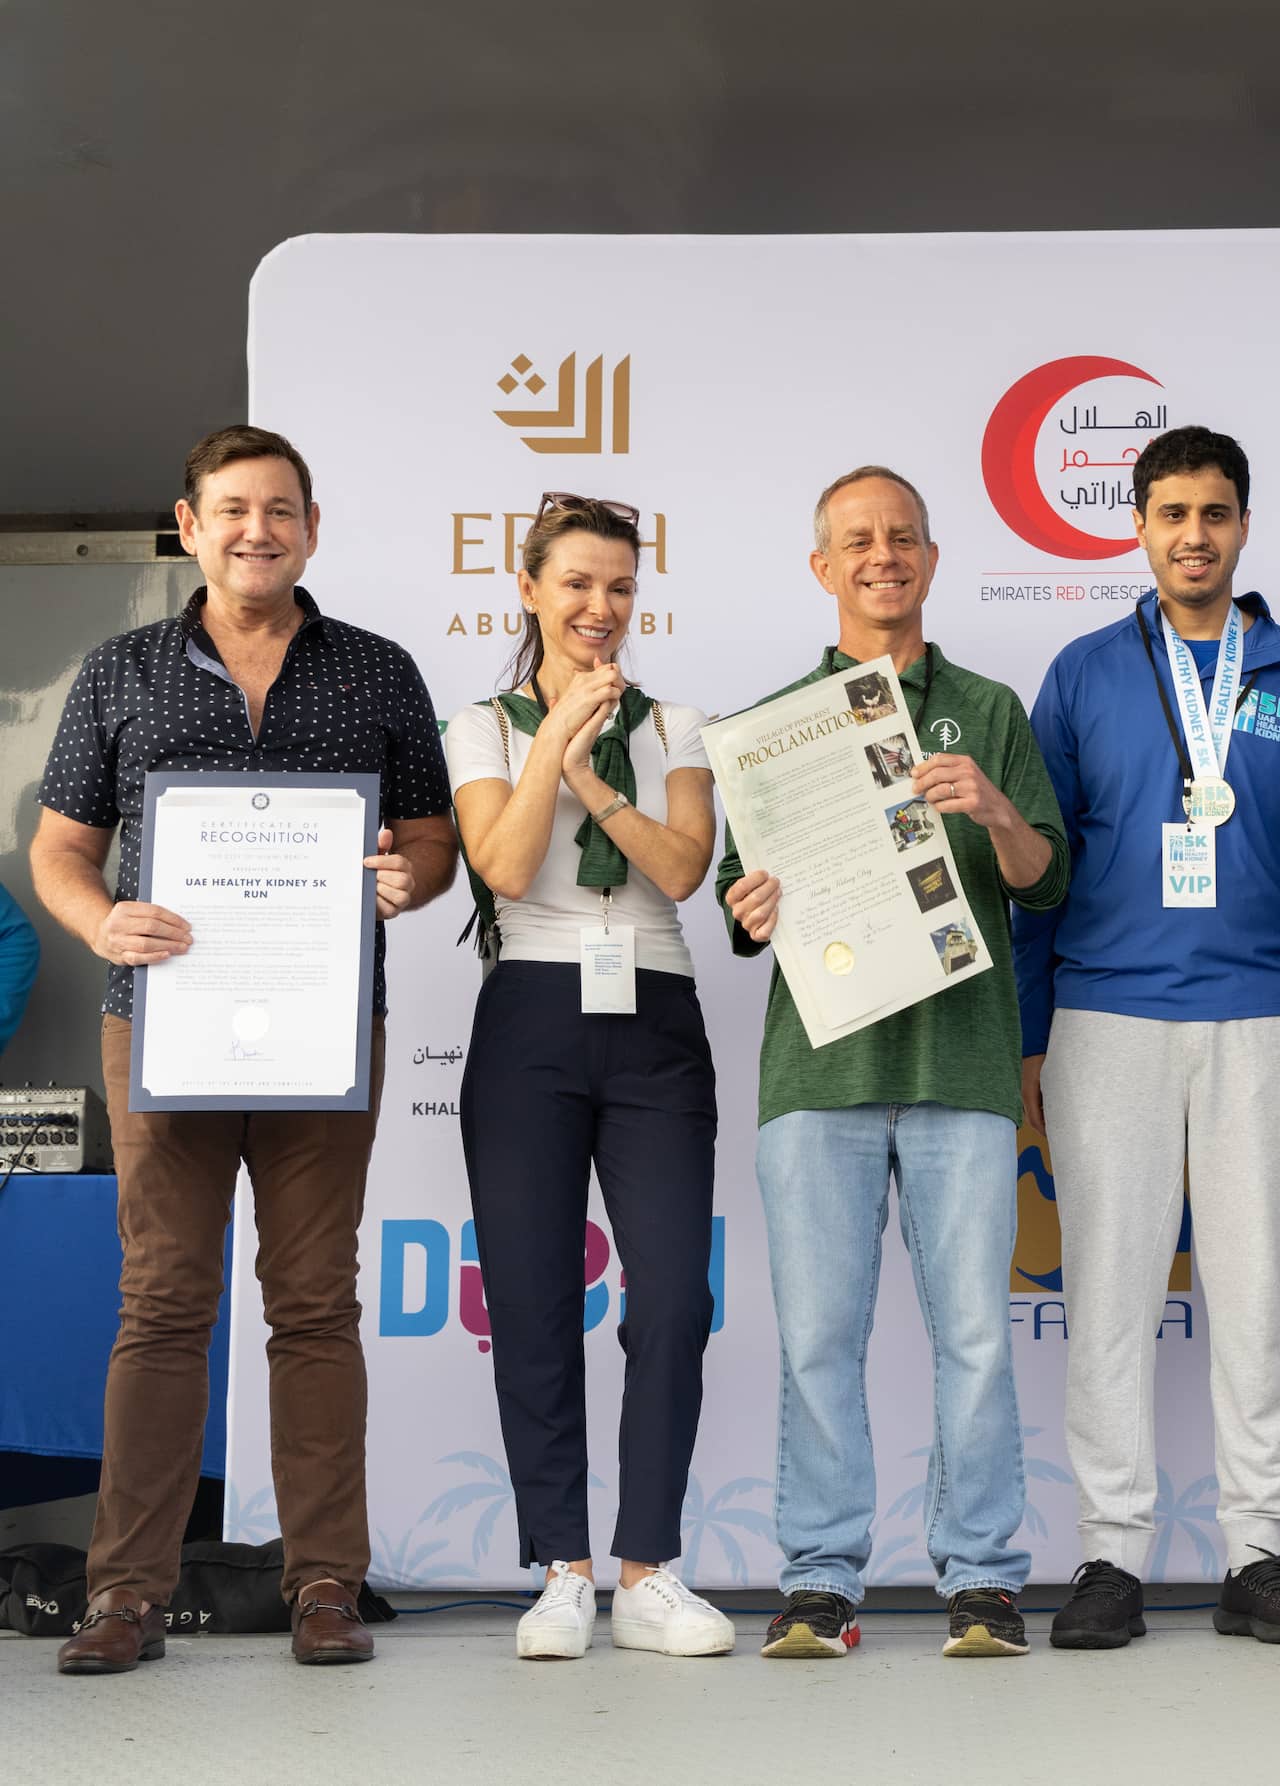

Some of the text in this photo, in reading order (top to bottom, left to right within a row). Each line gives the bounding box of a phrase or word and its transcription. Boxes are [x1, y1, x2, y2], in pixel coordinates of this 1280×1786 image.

[1059, 405, 1167, 435] الهلال
[981, 585, 1152, 601] EMIRATES RED CRESCE
[446, 612, 523, 636] ABU
[1213, 664, 1235, 727] HEALTHY
[1224, 621, 1239, 667] KIDNEY
[1183, 688, 1206, 743] KIDNEY
[1257, 712, 1276, 724] UAE
[737, 708, 862, 771] PROCLAMATION
[200, 831, 319, 844] RECOGNITION
[1184, 835, 1208, 848] 5K
[185, 878, 328, 888] UAE HEALTHY KIDNEY 5K
[1169, 875, 1213, 894] VIP
[244, 890, 268, 899] RUN
[412, 1102, 461, 1115] KHAL
